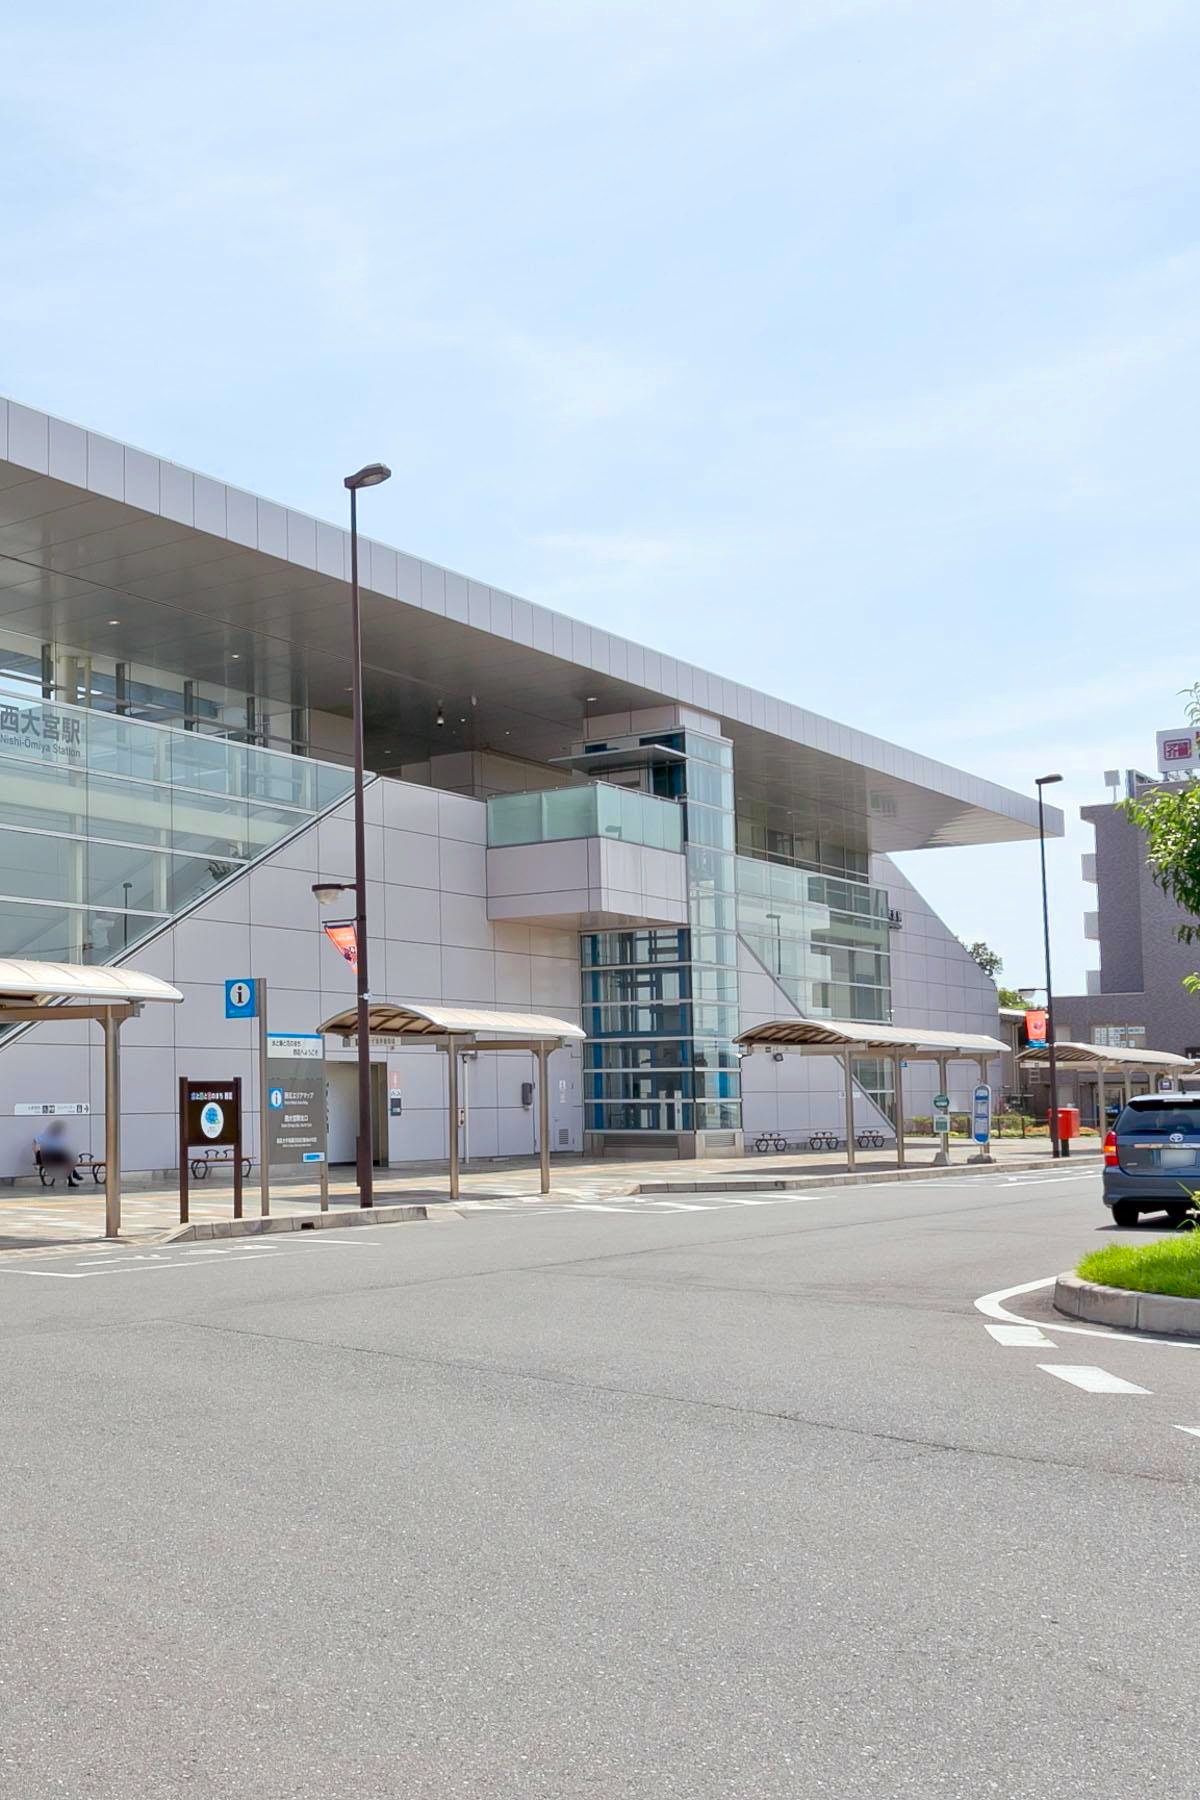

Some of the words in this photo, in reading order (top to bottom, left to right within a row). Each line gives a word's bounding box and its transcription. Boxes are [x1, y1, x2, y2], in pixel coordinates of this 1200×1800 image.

[0, 703, 81, 745] 西大宮駅
[53, 744, 81, 758] Station
